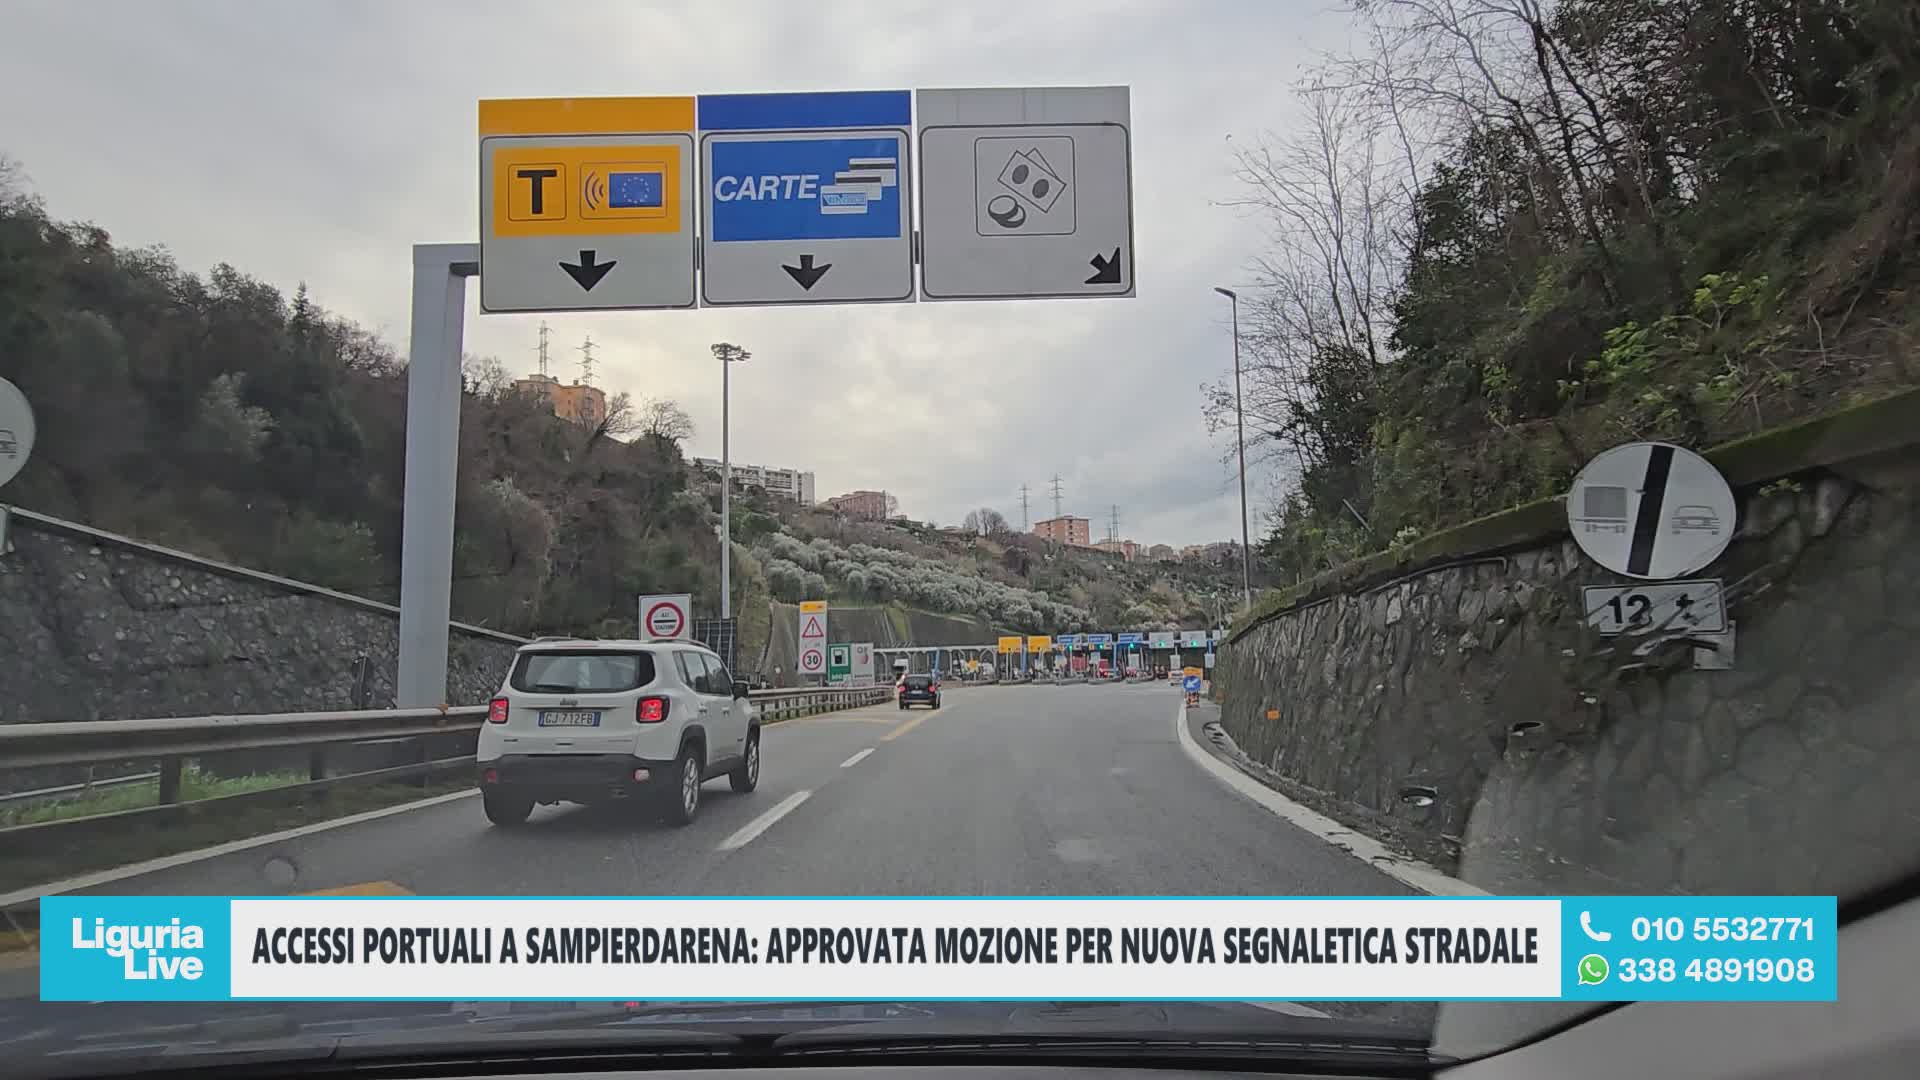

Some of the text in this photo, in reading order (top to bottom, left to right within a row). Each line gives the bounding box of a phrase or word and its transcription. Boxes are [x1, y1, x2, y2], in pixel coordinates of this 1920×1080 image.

[516, 169, 558, 215] T
[714, 174, 819, 203] CARTE
[806, 655, 819, 666] 30
